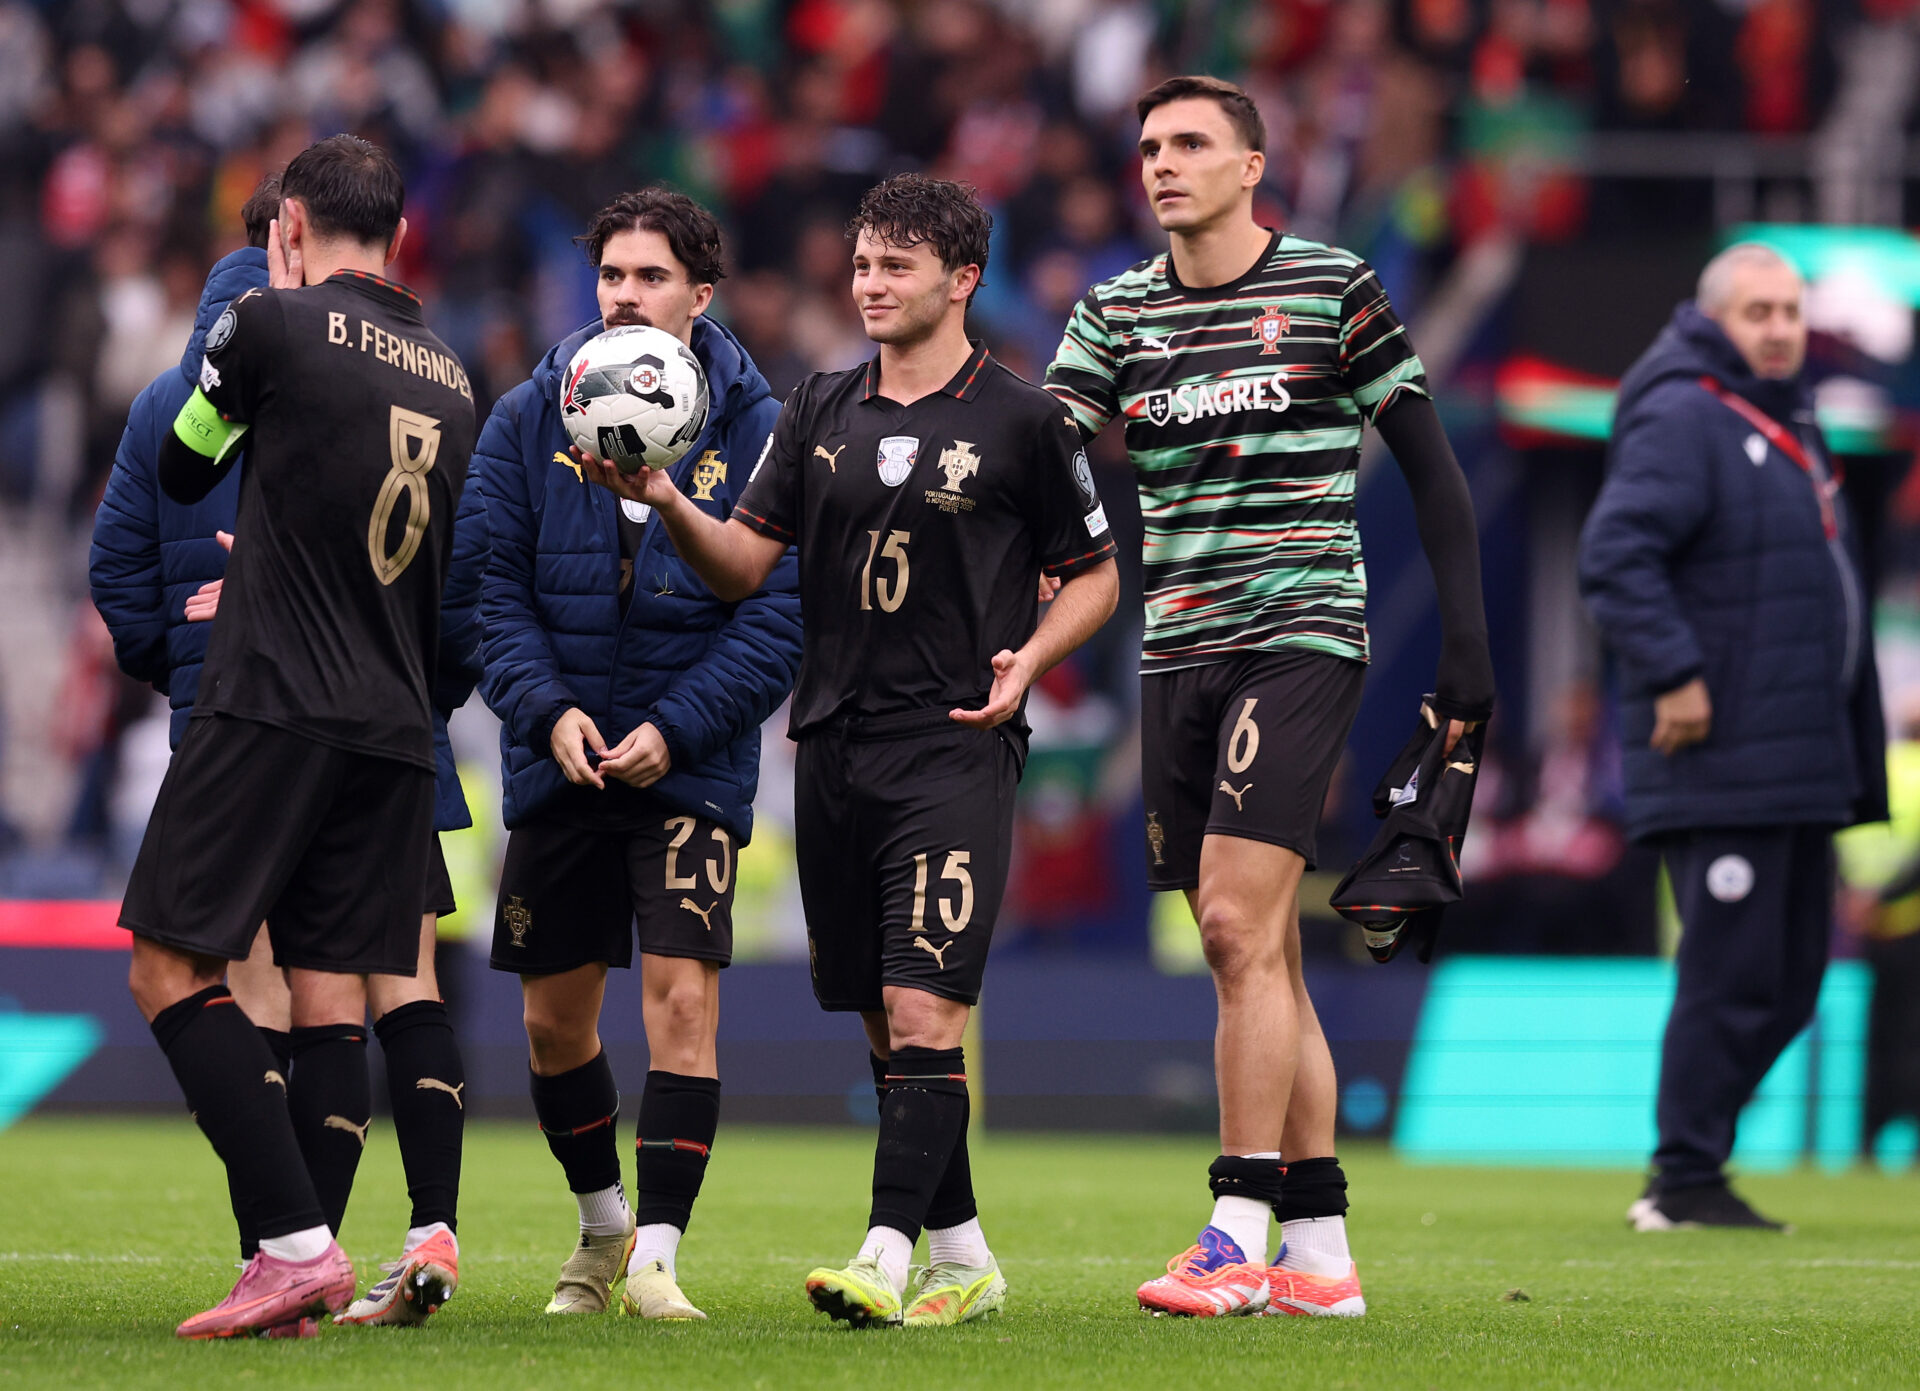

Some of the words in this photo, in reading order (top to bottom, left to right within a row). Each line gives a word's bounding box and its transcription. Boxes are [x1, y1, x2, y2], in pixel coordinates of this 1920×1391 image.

[328, 311, 353, 348] B.
[1175, 371, 1291, 425] SAGRES
[368, 404, 442, 586] 8
[860, 529, 911, 613] 15
[1227, 698, 1260, 774] 6
[906, 850, 974, 933] 15
